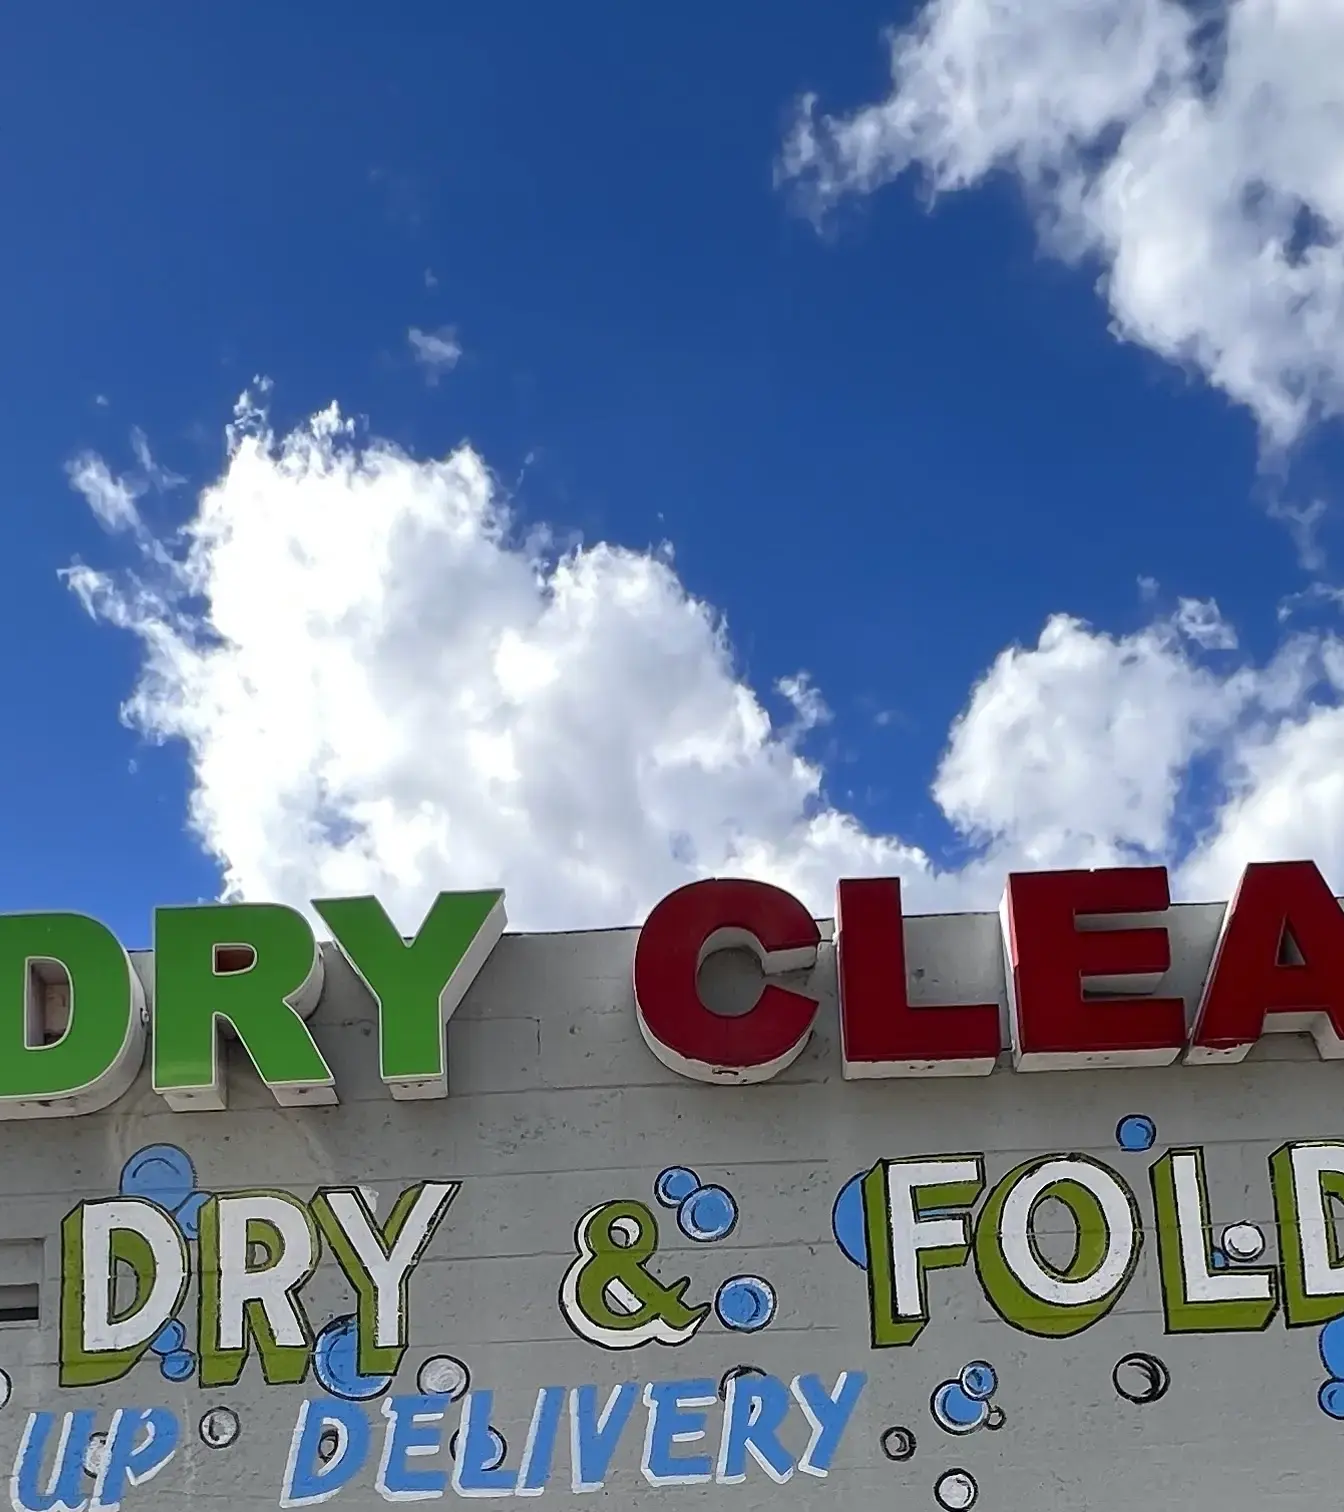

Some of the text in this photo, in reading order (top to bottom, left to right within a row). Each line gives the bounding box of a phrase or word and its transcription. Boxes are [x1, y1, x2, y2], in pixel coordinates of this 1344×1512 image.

[59, 1181, 461, 1388] DRY
[559, 1198, 710, 1349] &
[280, 1370, 866, 1509] DELIVERY
